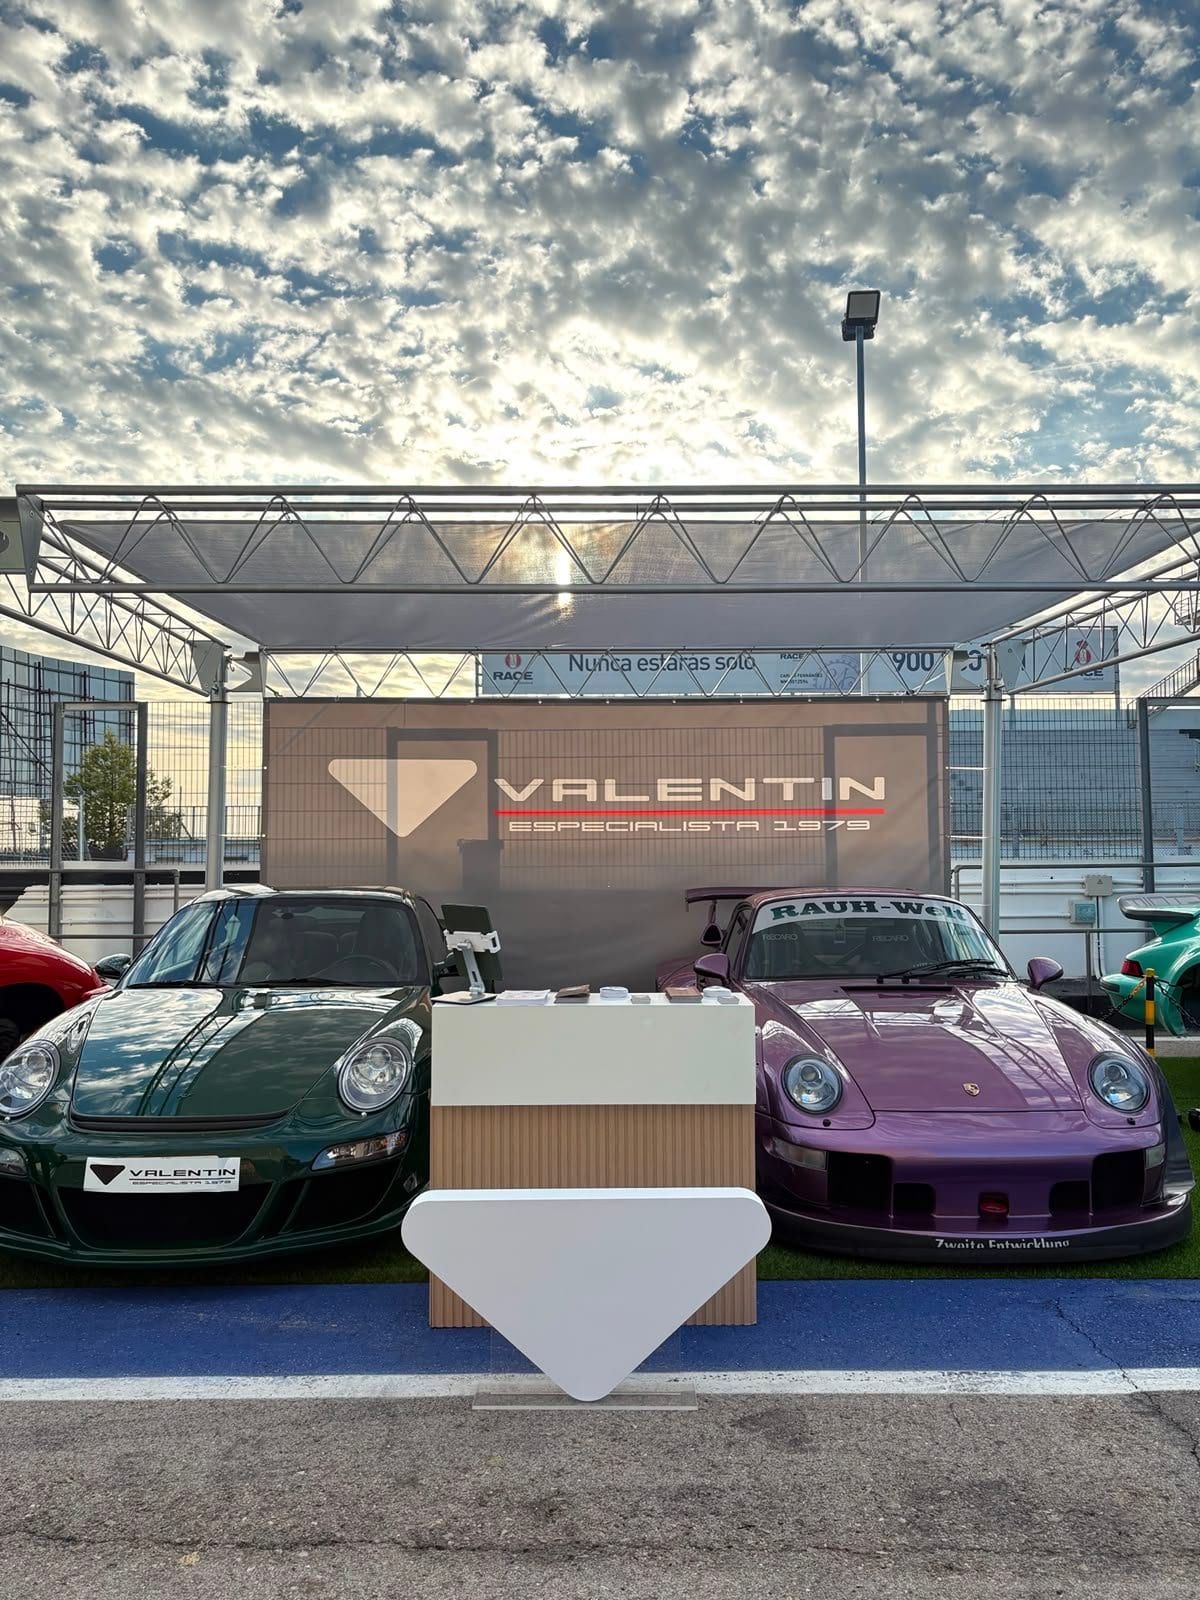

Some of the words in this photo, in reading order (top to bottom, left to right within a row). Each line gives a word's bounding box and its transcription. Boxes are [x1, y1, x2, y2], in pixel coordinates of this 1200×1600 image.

[569, 653, 631, 672] Nunca
[715, 654, 755, 671] solo
[892, 652, 934, 671] 900
[493, 671, 533, 680] RACE
[494, 776, 885, 802] VALENTIN
[509, 820, 759, 832] ESPECIALISTA
[774, 819, 870, 831] 1979
[762, 933, 798, 942] RECARO
[872, 934, 910, 942] RECARO
[130, 1168, 236, 1177] VALENTIN
